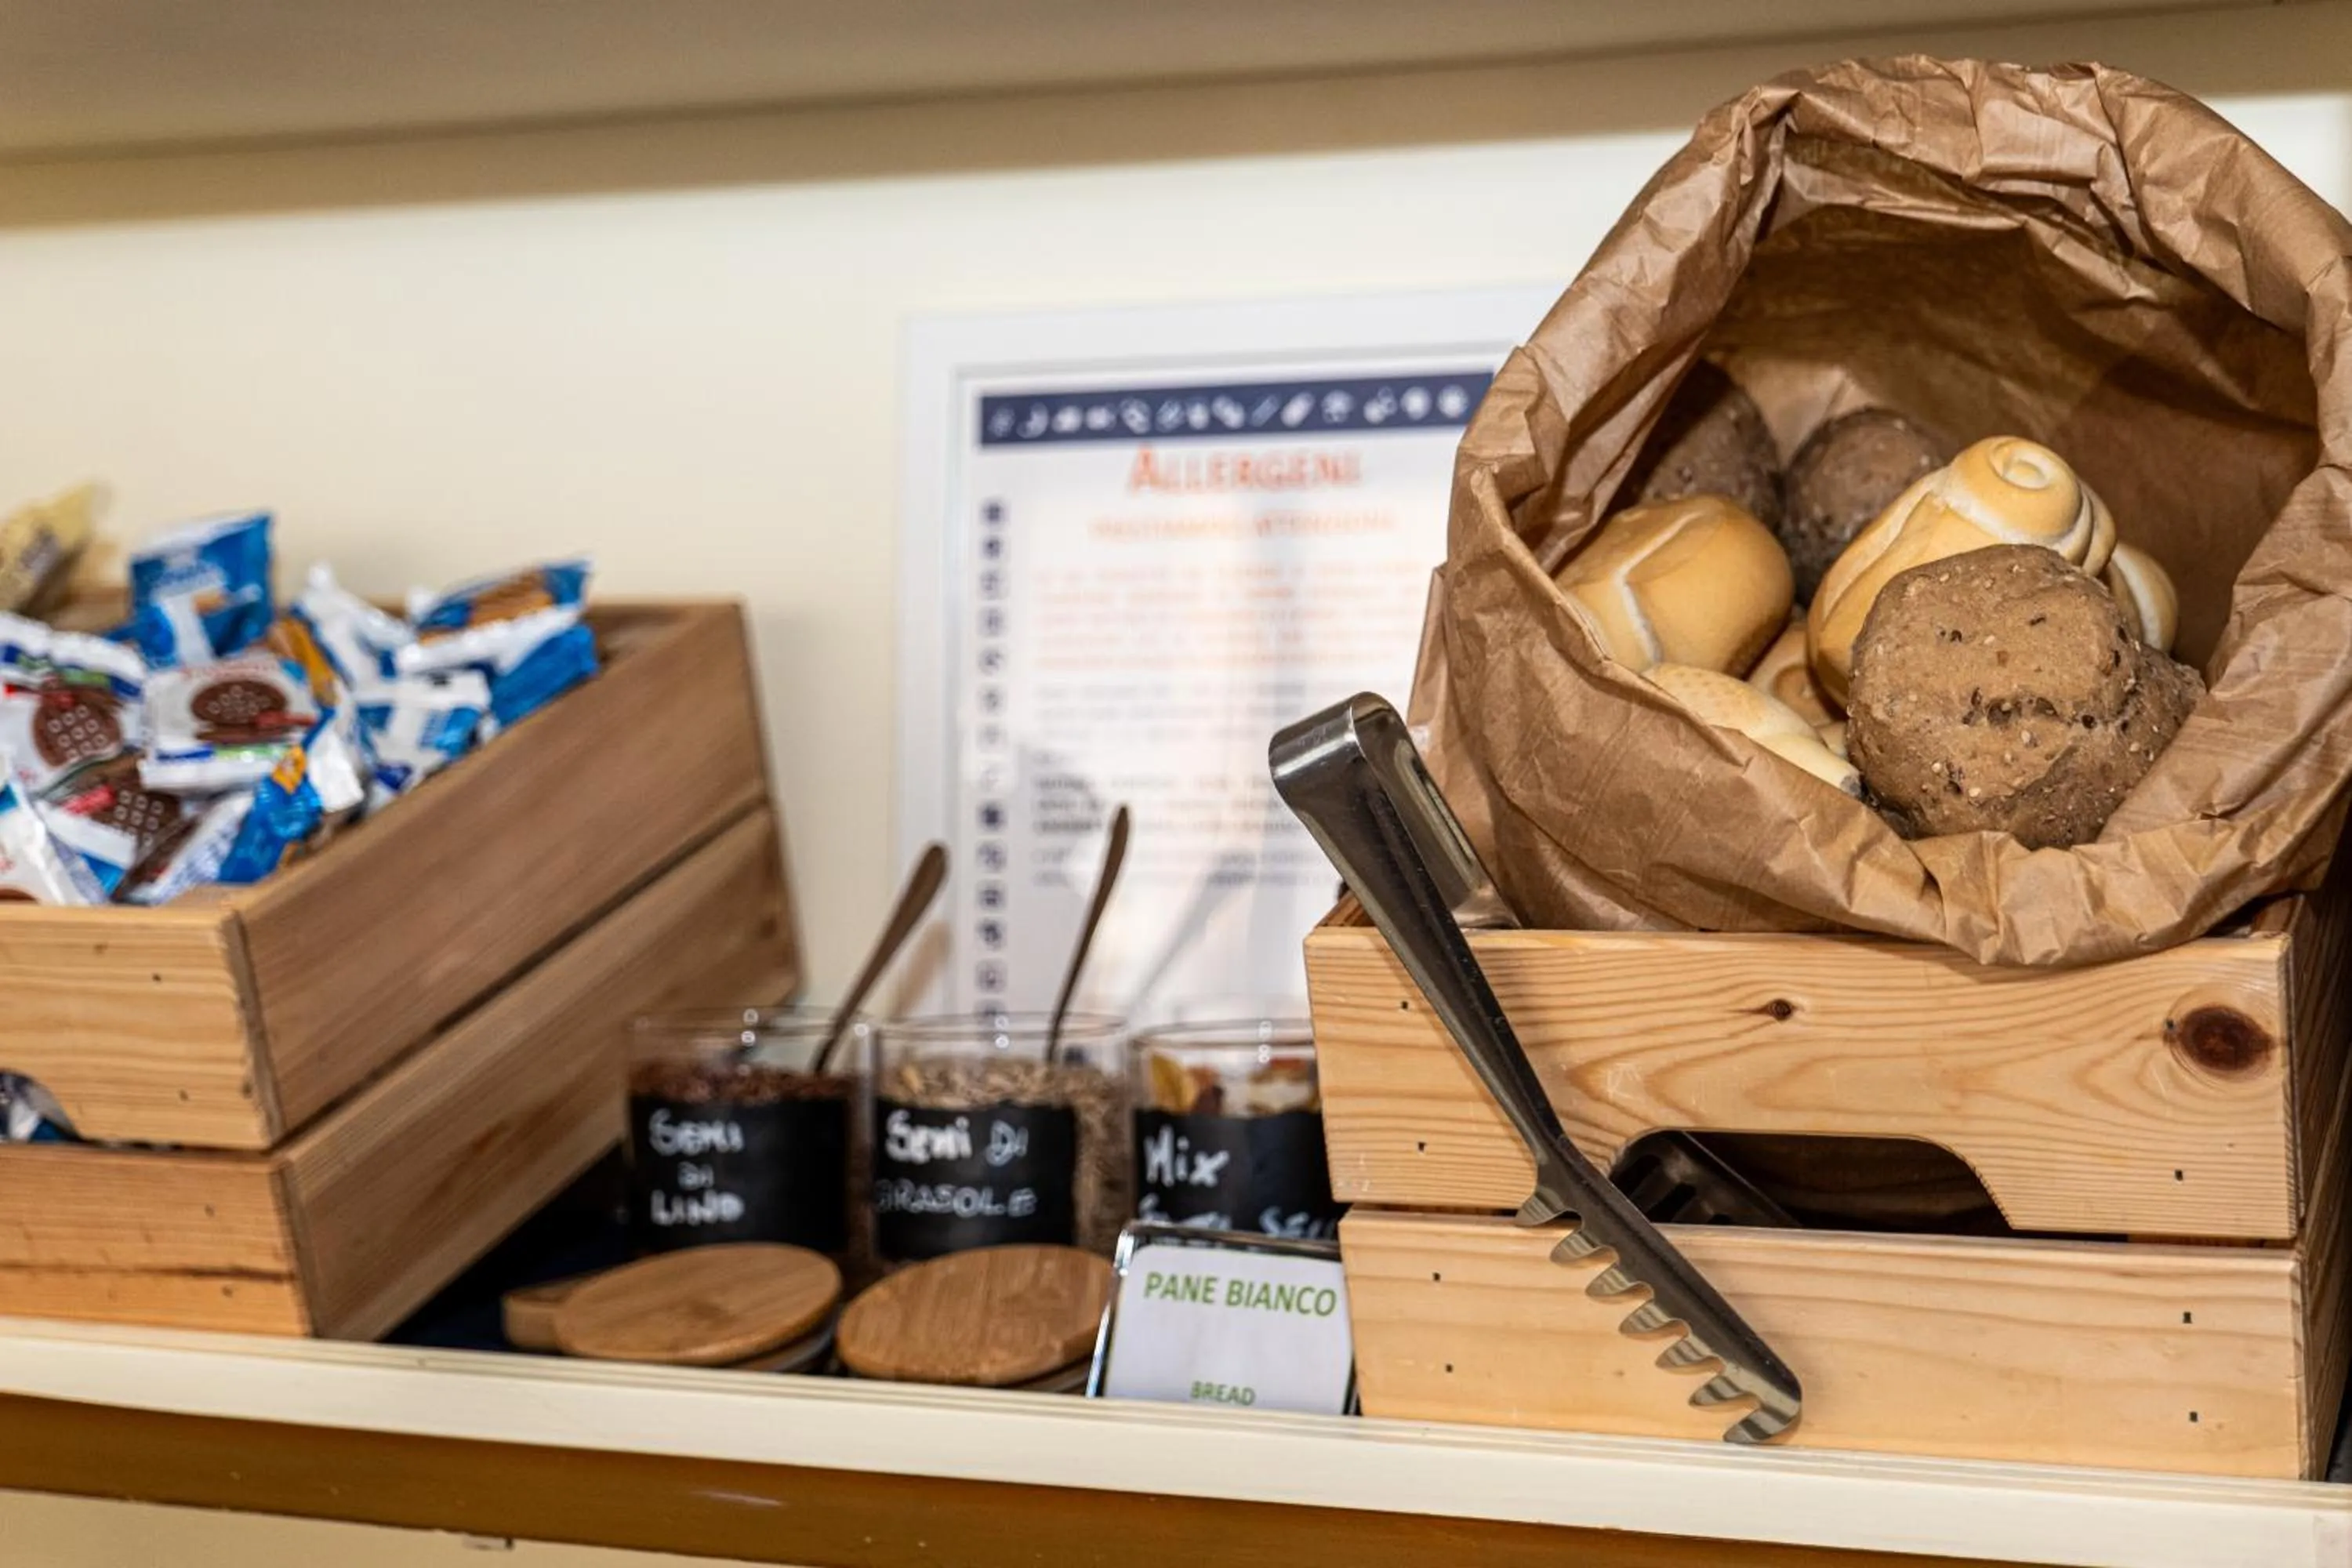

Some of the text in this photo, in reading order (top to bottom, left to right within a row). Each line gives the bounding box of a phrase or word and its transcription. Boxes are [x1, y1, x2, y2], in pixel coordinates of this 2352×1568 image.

[1143, 1271, 1337, 1316] PANE BIANCO
[1190, 1380, 1256, 1406] BREAD
